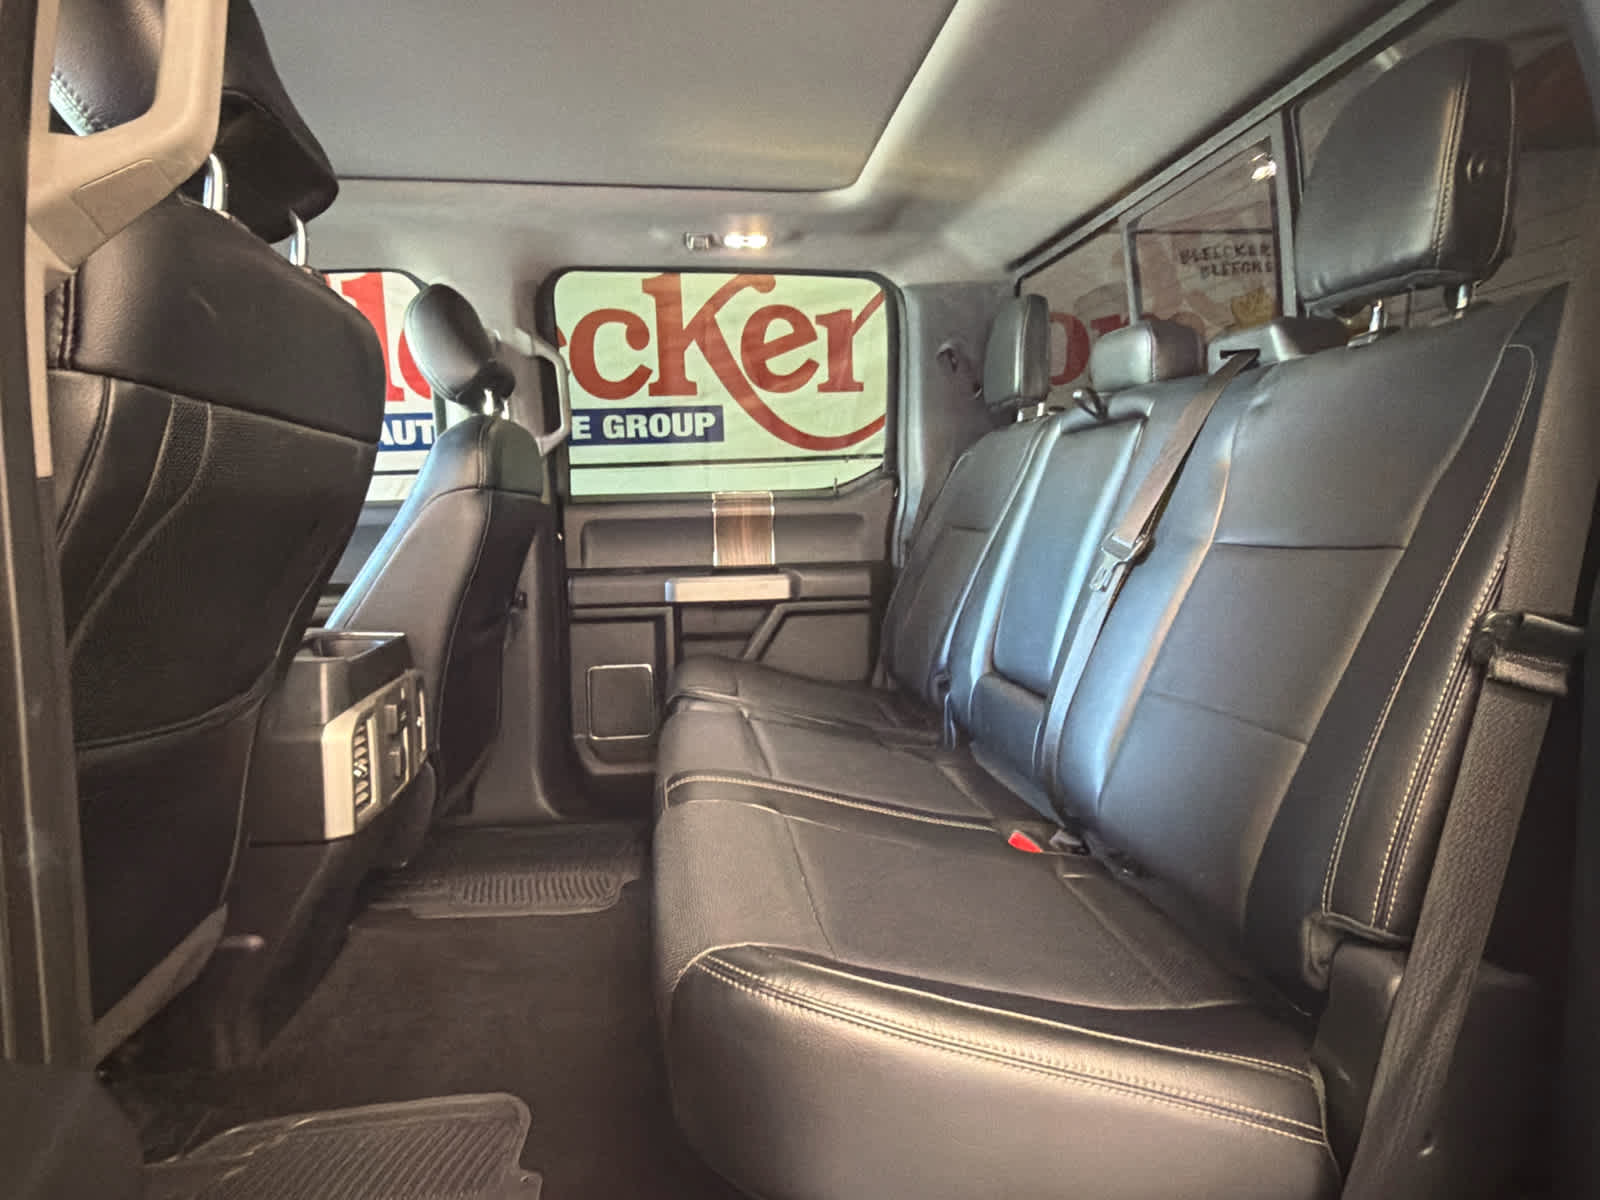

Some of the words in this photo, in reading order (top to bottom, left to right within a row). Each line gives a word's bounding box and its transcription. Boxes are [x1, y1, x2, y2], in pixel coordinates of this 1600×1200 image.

[1200, 261, 1273, 278] BLEECKE
[380, 419, 434, 446] AUT
[571, 415, 592, 440] E
[602, 411, 716, 439] GROUP
